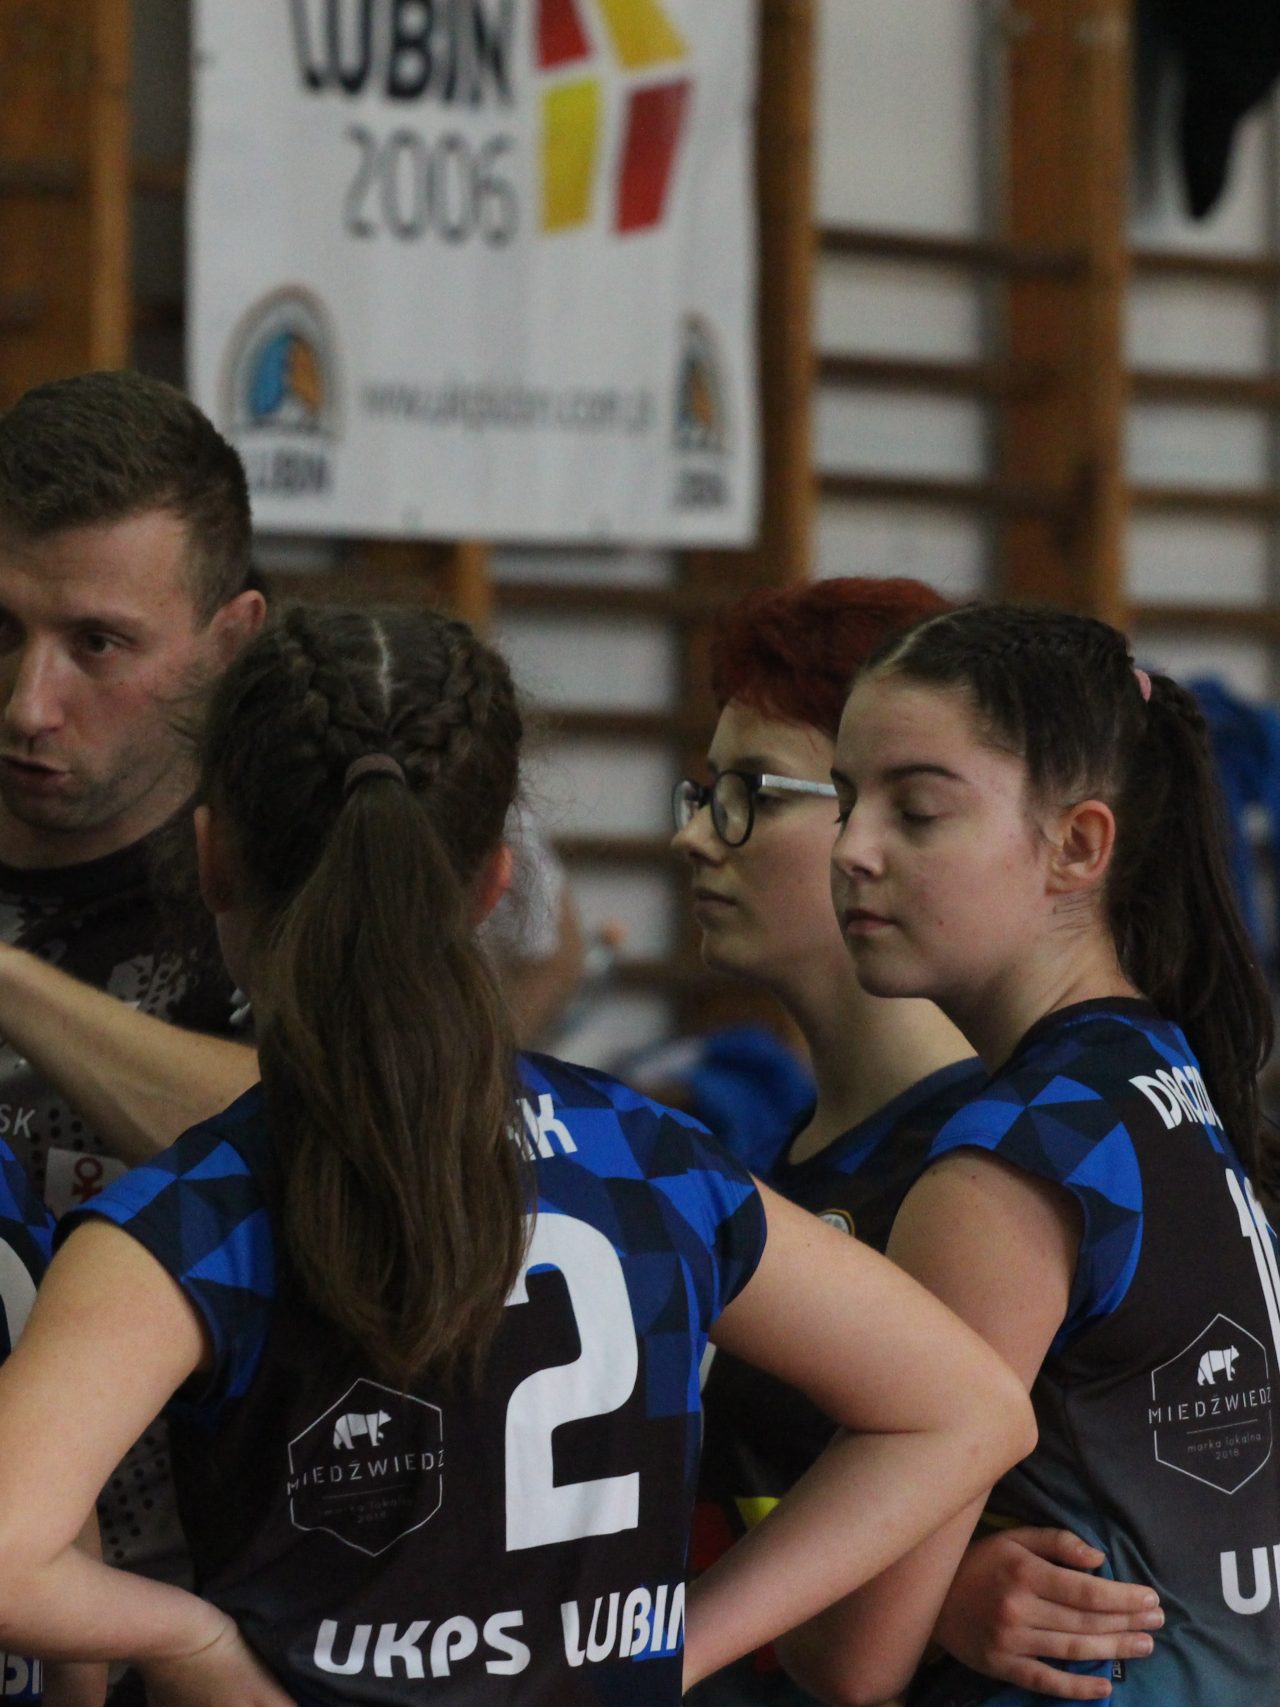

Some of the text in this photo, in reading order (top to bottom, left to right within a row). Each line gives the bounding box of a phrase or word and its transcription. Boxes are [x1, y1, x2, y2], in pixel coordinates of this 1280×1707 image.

[290, 0, 516, 105] LUBIN
[344, 125, 519, 248] 2006
[503, 1211, 640, 1552] 2
[1220, 1542, 1280, 1615] U
[313, 1610, 531, 1680] UKPS
